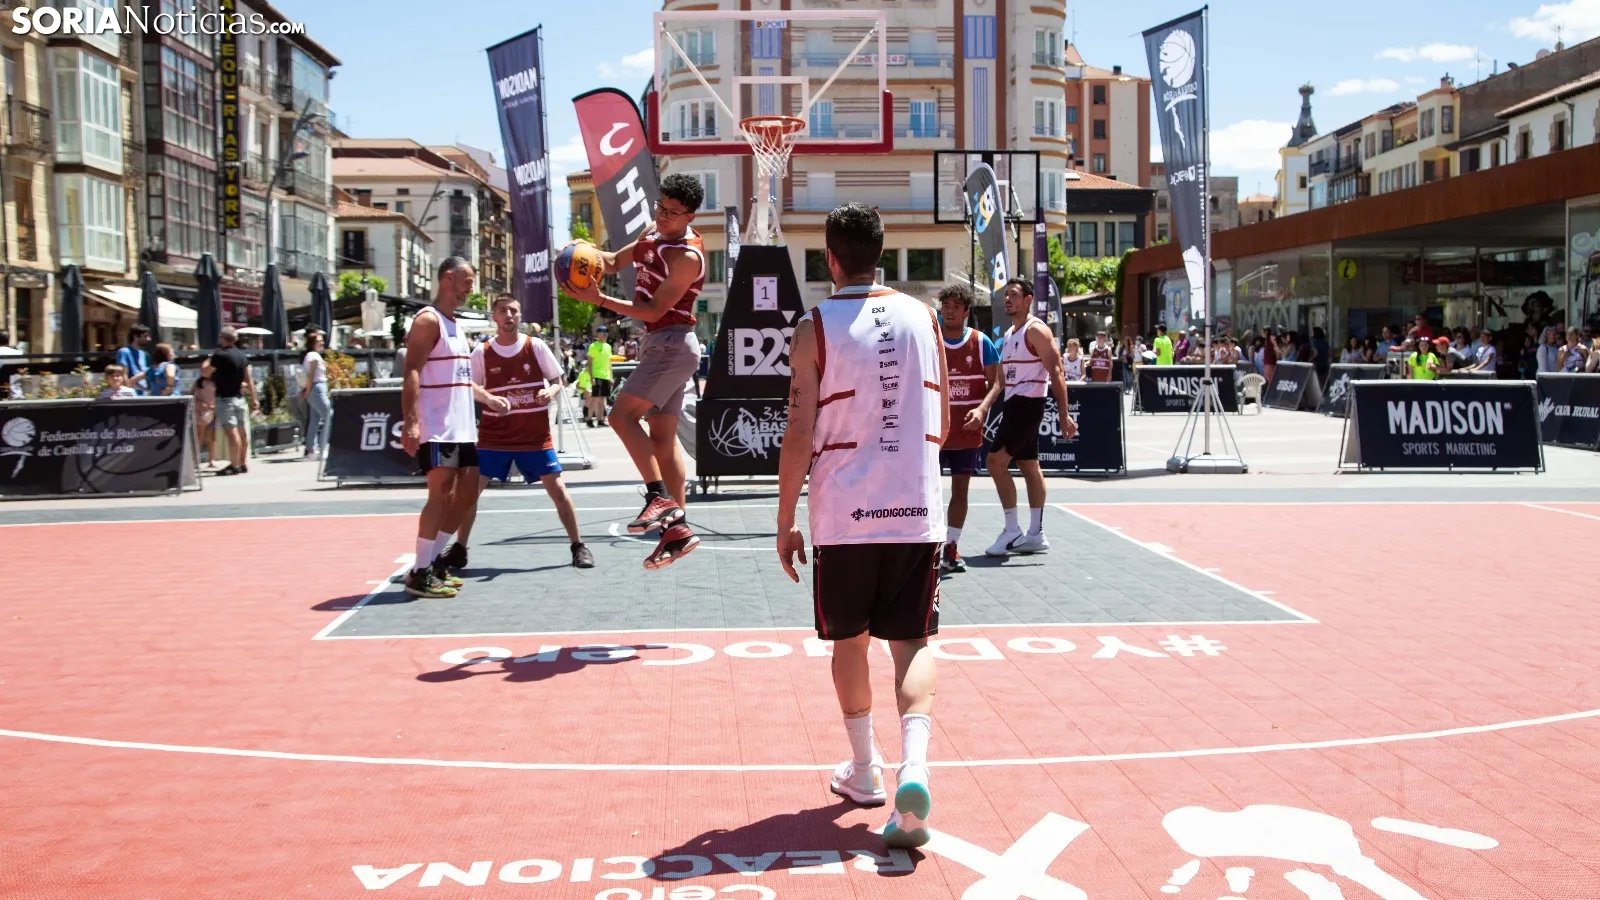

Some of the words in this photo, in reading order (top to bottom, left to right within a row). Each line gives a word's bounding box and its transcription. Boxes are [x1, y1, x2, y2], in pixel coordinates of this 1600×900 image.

[761, 286, 770, 300] 1
[1387, 400, 1504, 436] MADISON
[1572, 405, 1599, 418] RURAL
[760, 421, 788, 433] BAS
[99, 428, 115, 440] de
[761, 432, 784, 448] TO
[37, 444, 53, 457] de
[1403, 442, 1440, 456] SPORTS
[1446, 442, 1497, 456] MARKETING
[864, 507, 928, 519] #YODIGOCERO
[351, 849, 914, 890] REACCIONA
